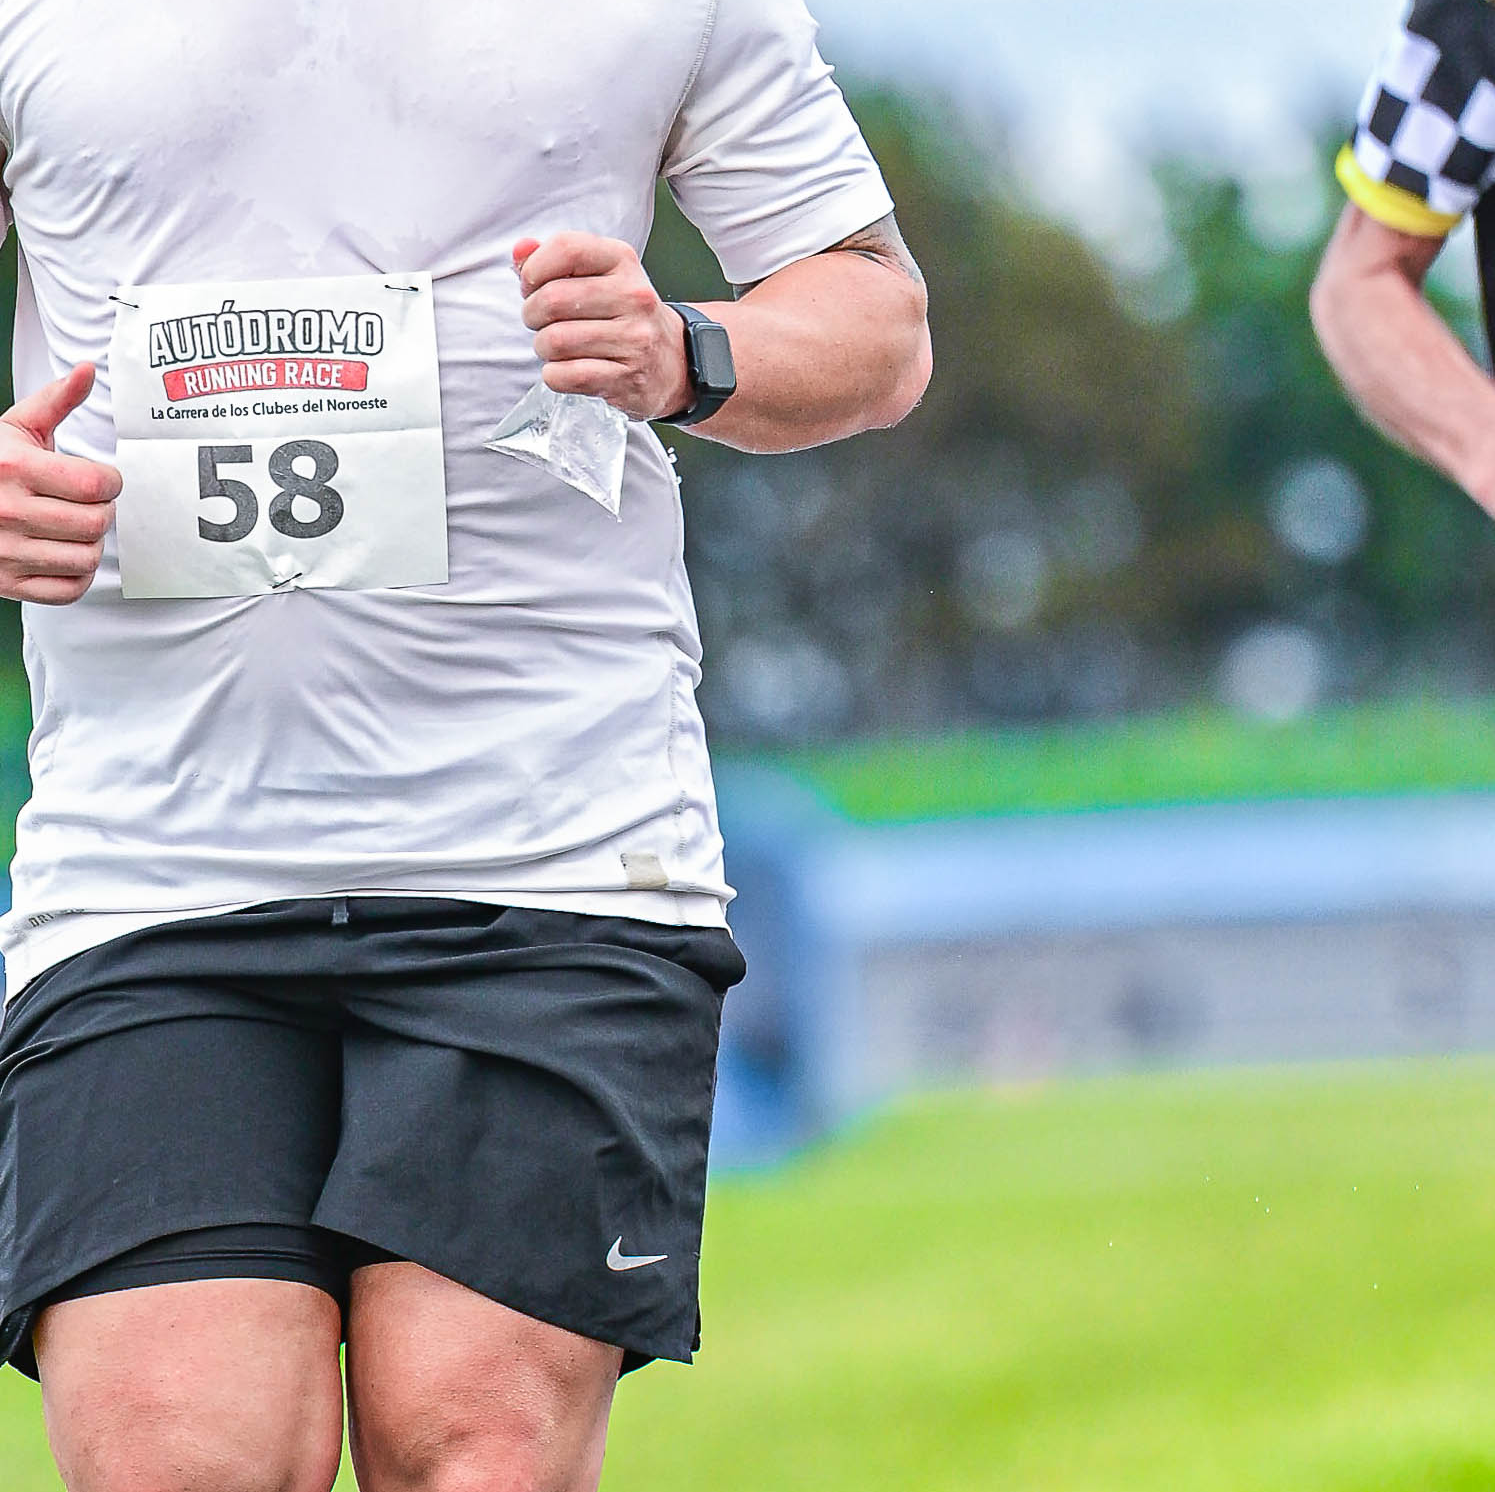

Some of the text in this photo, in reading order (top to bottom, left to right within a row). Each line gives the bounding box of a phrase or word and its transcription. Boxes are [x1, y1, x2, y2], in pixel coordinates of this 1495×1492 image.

[150, 300, 383, 368] AUTÓDROMO
[183, 362, 344, 395] RUNNING RACE
[151, 397, 388, 419] La Carrera de los Clubes del Noroeste
[198, 440, 344, 542] 58
